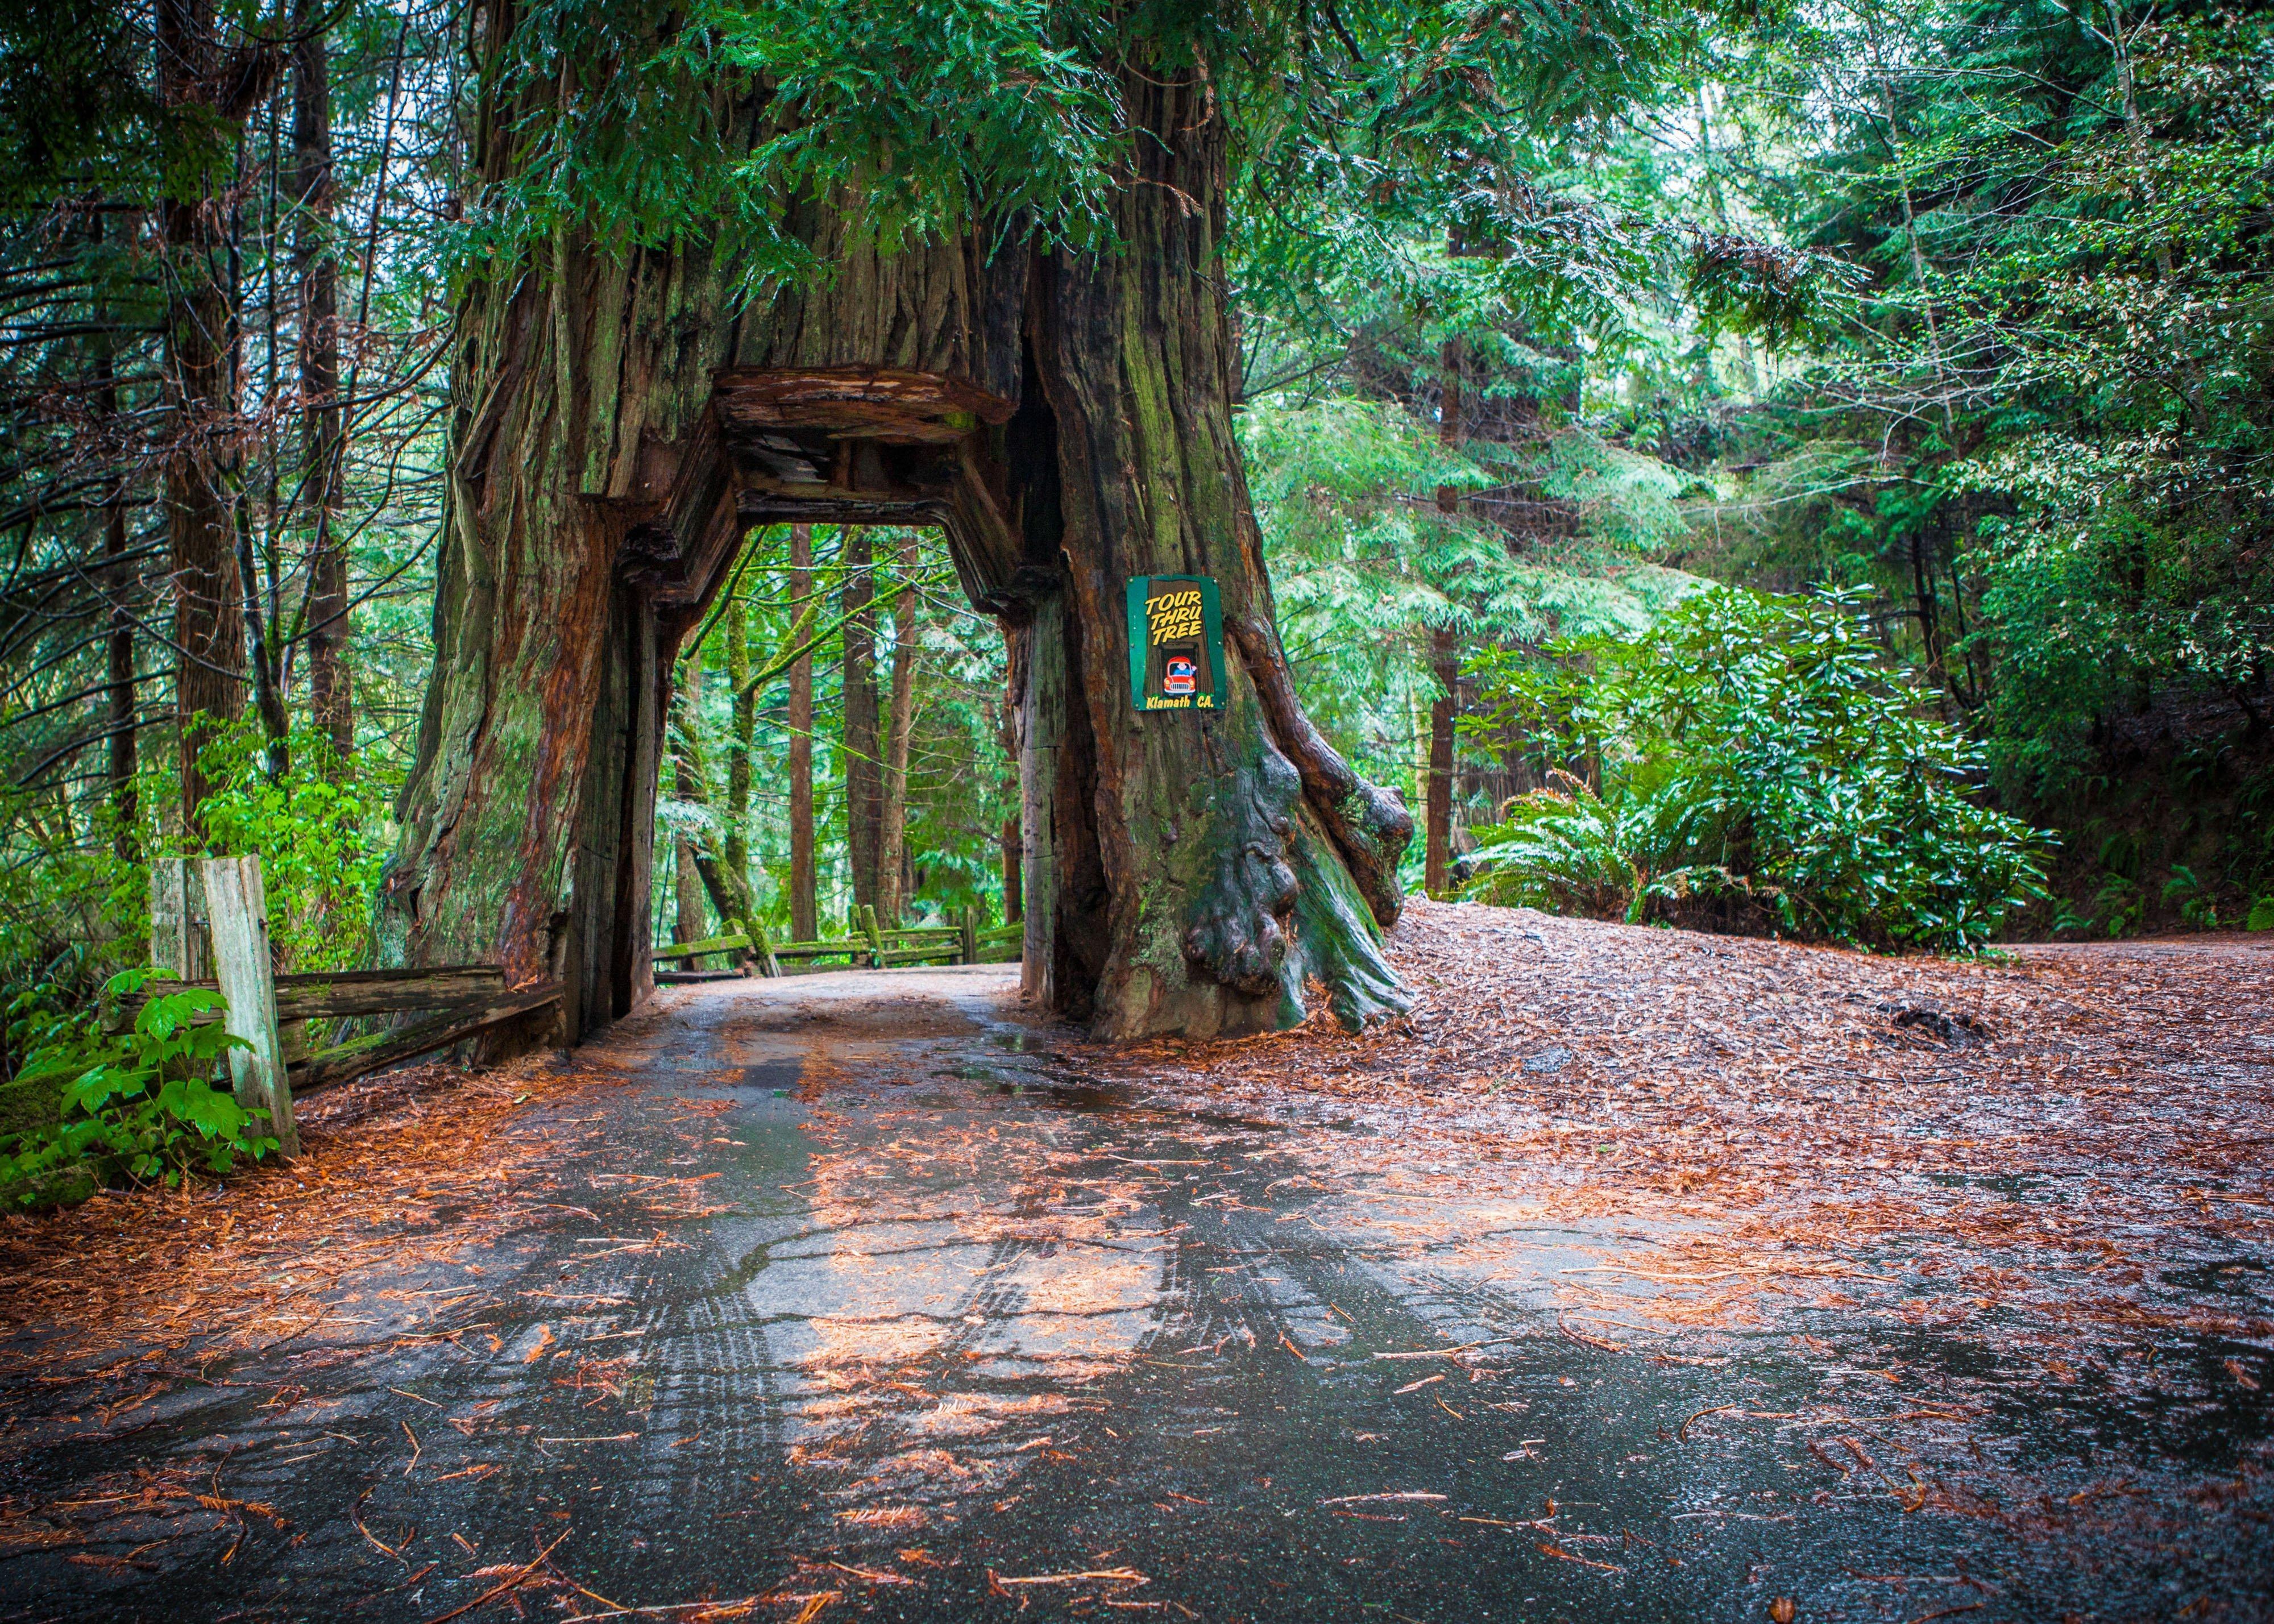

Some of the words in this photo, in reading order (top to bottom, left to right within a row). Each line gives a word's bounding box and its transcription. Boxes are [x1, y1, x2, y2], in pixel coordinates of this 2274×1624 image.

[1145, 591, 1201, 615] TOUR
[1151, 606, 1202, 630] THRU
[1153, 621, 1202, 645] TREE
[1146, 695, 1190, 709] Klamath
[1197, 695, 1214, 708] CA.
